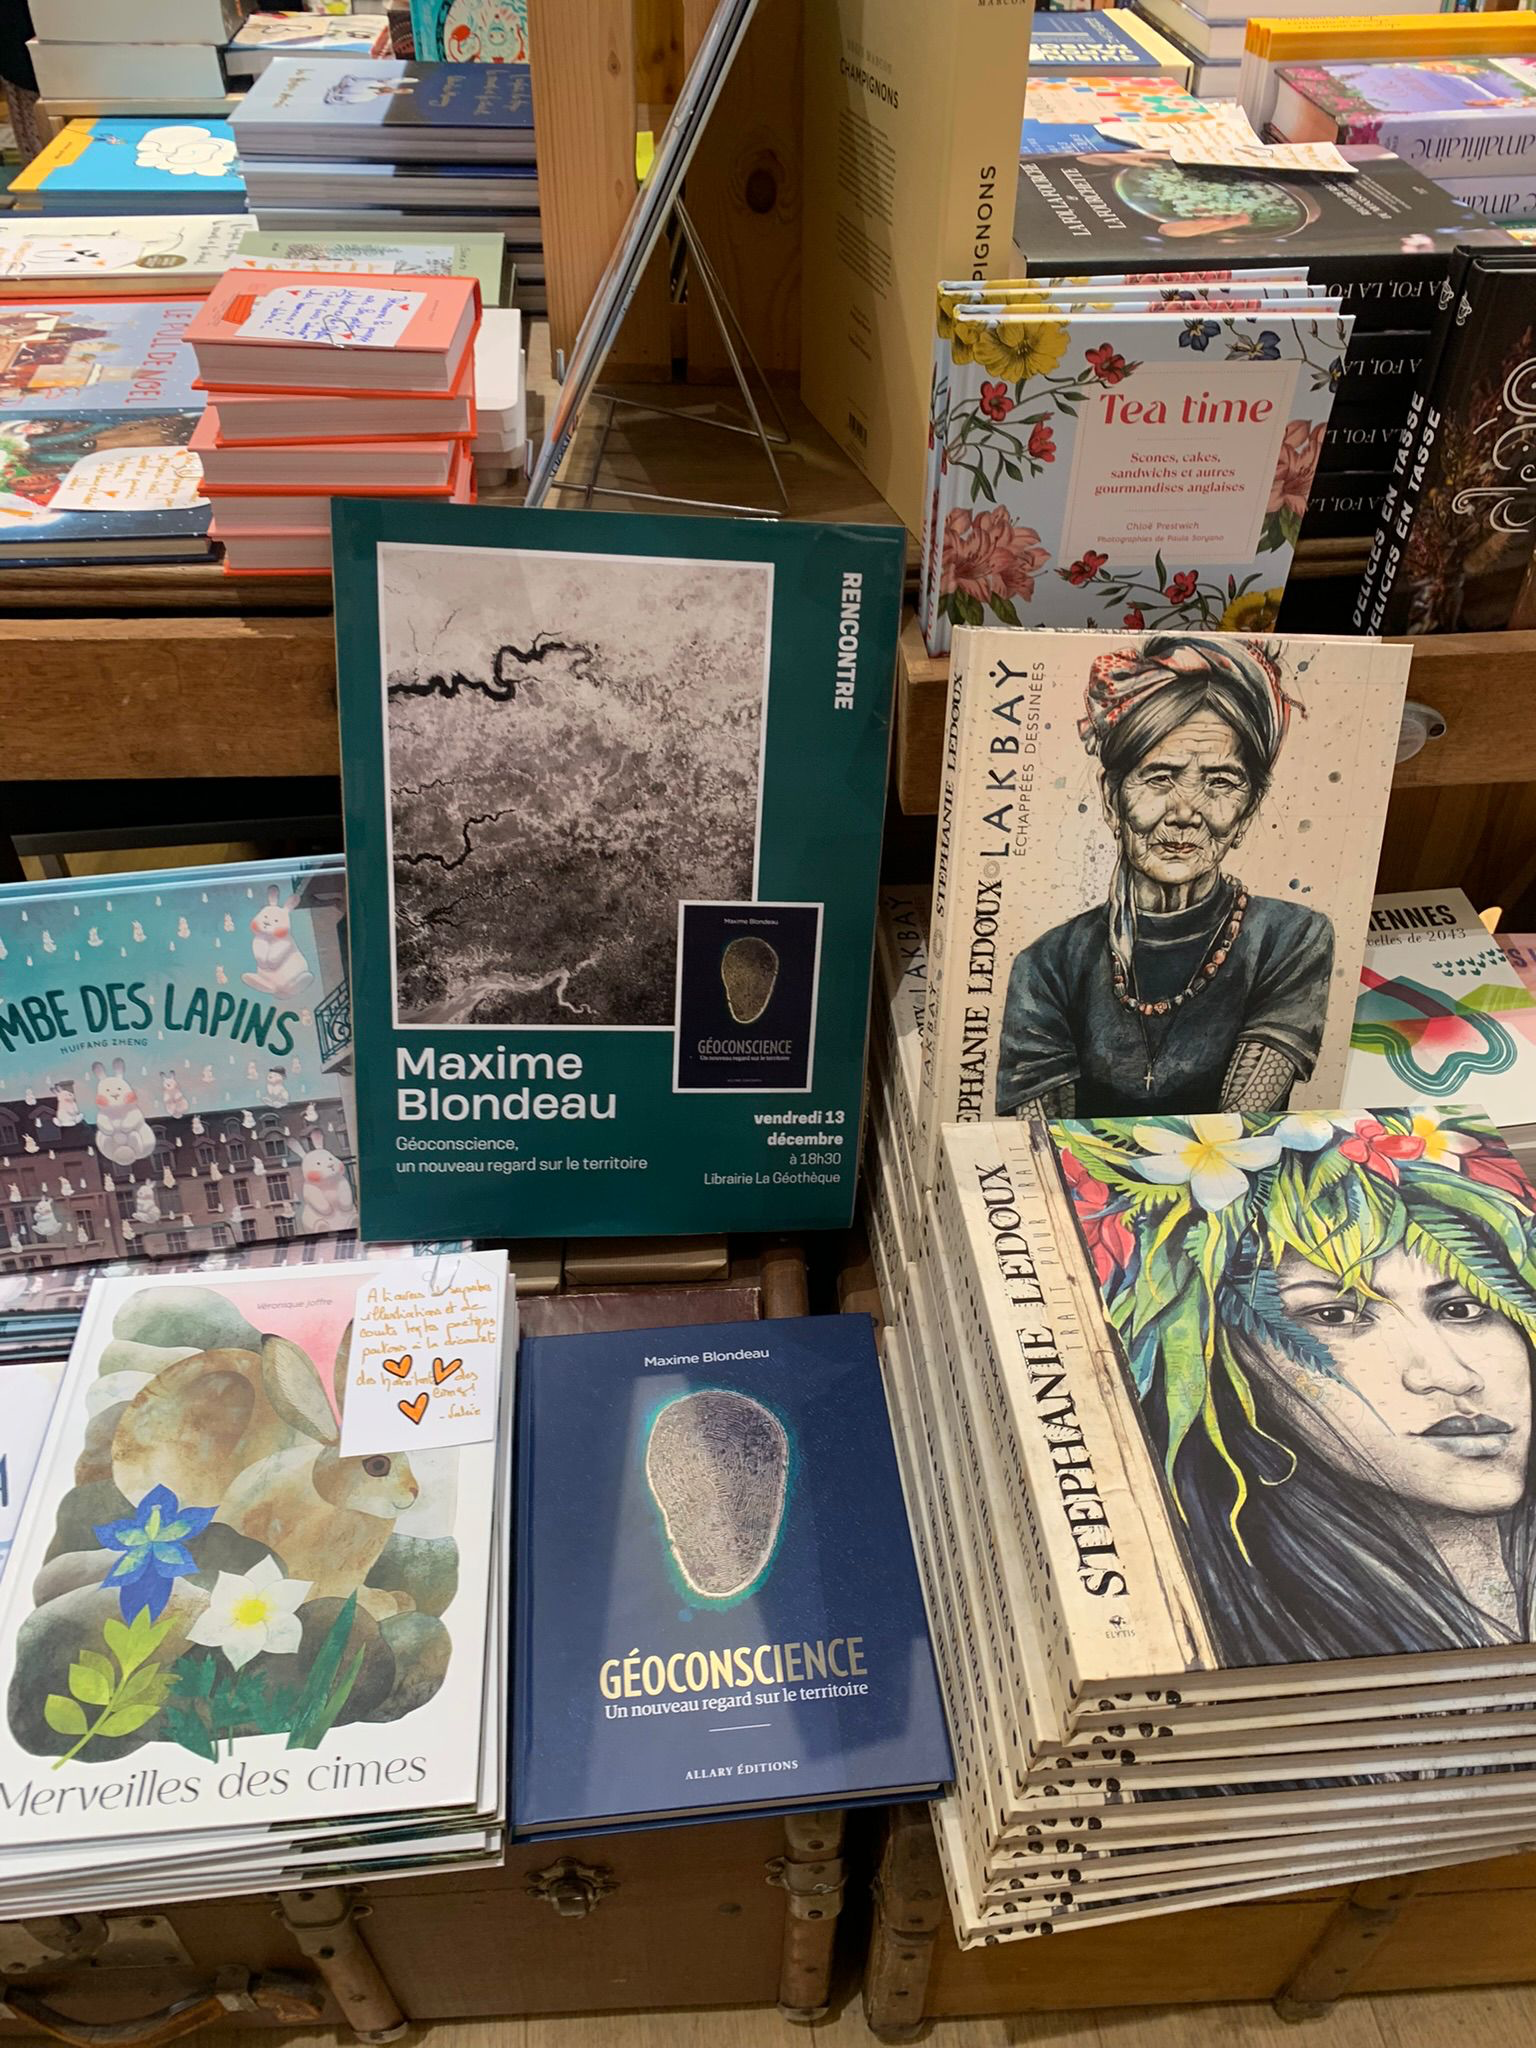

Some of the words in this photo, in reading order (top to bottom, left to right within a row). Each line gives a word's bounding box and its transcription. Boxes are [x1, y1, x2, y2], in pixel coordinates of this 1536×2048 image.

[839, 57, 899, 110] CHAMPIGNONS
[972, 164, 996, 280] PIGNONS
[162, 307, 194, 320] LE
[142, 351, 178, 367] DE
[124, 368, 173, 404] NOËL
[1100, 393, 1167, 425] Tea
[1182, 391, 1274, 424] time
[1110, 467, 1178, 479] sandwichs
[1180, 468, 1192, 478] et
[1196, 467, 1236, 478] autres
[1130, 452, 1179, 464] Scones,
[1182, 451, 1221, 464] cakes,
[1381, 482, 1399, 526] EN
[1392, 389, 1425, 475] TASSE
[1396, 502, 1415, 541] EN
[1408, 405, 1442, 493] TASSE
[1094, 482, 1184, 497] gourmandises
[1187, 481, 1245, 495] anglaises
[1156, 521, 1200, 531] Prestwich
[834, 572, 863, 710] RENCONTRE
[1012, 763, 1035, 857] ÉCHAPPÉES
[1024, 661, 1045, 754] DESSINÉES
[936, 779, 955, 918] STEPHANIE
[949, 672, 964, 773] LEDOUX
[966, 878, 1003, 996] LEDOUX
[1366, 934, 1403, 947] velles
[1407, 932, 1422, 944] de
[1426, 927, 1467, 943] 2043
[0, 989, 77, 1053] MBE
[79, 982, 154, 1033] DES
[164, 982, 300, 1057] LAPINS
[111, 1037, 149, 1047] ZHENG
[697, 1036, 793, 1055] GÉOCONSCIENCE
[396, 1045, 583, 1080] Maxime
[955, 1004, 990, 1124] EPHANIE
[397, 1086, 617, 1122] Blondeau
[754, 1110, 822, 1125] vendredi
[824, 1110, 846, 1125] 13
[396, 1136, 519, 1152] Géoconscience,
[767, 1131, 844, 1146] décembre
[396, 1160, 416, 1173] un
[418, 1159, 484, 1173] nouveau
[487, 1157, 537, 1174] regard
[539, 1158, 563, 1171] sur
[566, 1157, 580, 1170] le
[583, 1155, 649, 1170] territoire
[789, 1153, 797, 1165] à
[800, 1152, 842, 1165] 18h30
[1008, 1145, 1041, 1200] TRAIT
[704, 1171, 753, 1185] Librairie
[755, 1172, 770, 1184] La
[772, 1171, 841, 1185] Géothèque
[974, 1162, 1048, 1308] LEDOUX
[1027, 1217, 1054, 1266] POUR
[368, 1287, 377, 1303] A
[1048, 1284, 1085, 1351] TRAIT
[643, 1353, 700, 1368] Maxime
[702, 1348, 770, 1364] Blondeau
[1016, 1325, 1130, 1599] STEPHANIE
[599, 1636, 868, 1700] GÉOCONSCIENCE
[604, 1704, 629, 1720] Un
[630, 1698, 699, 1718] nouveau
[701, 1691, 752, 1716] regard
[754, 1691, 780, 1705] sur
[782, 1686, 797, 1702] le
[799, 1680, 868, 1701] territoire
[0, 1769, 201, 1817] Merveilles
[217, 1761, 290, 1800] des
[307, 1755, 428, 1793] cimes
[685, 1765, 734, 1781] ALLARY
[736, 1758, 799, 1775] ÉDITIONS
